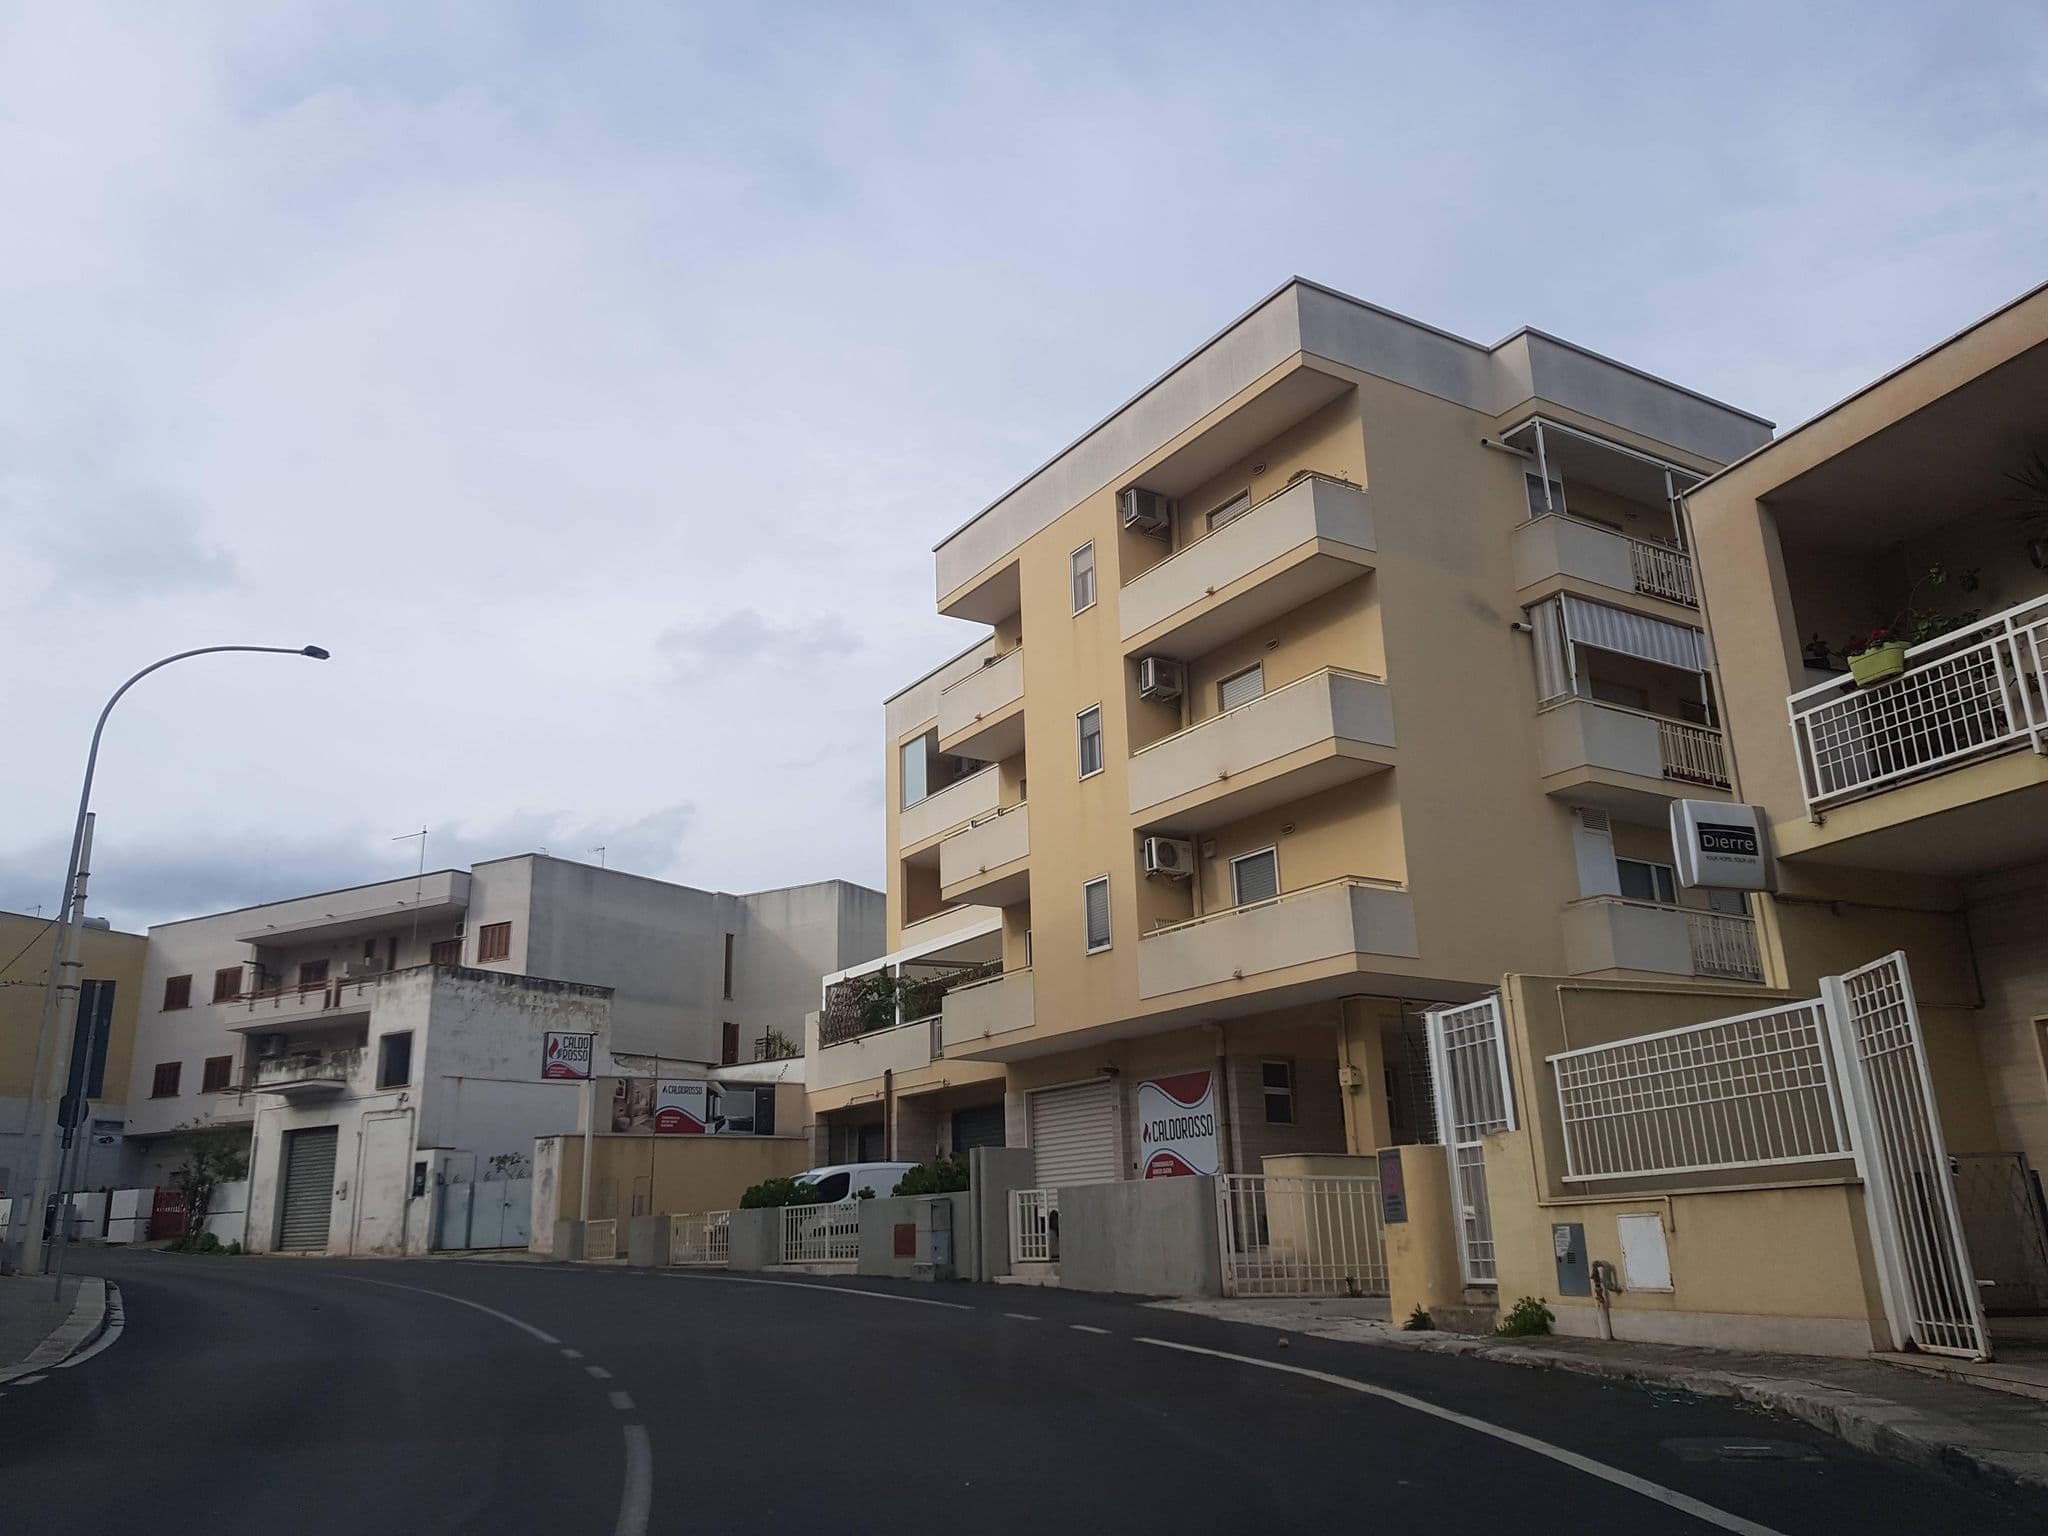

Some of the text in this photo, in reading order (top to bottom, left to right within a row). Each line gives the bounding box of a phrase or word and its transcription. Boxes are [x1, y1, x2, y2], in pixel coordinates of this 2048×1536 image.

[1703, 834, 1754, 851] Dierre
[563, 1036, 588, 1049] CALDO
[562, 1048, 588, 1061] ROSSO
[1152, 1114, 1214, 1142] CALDOROSSO
